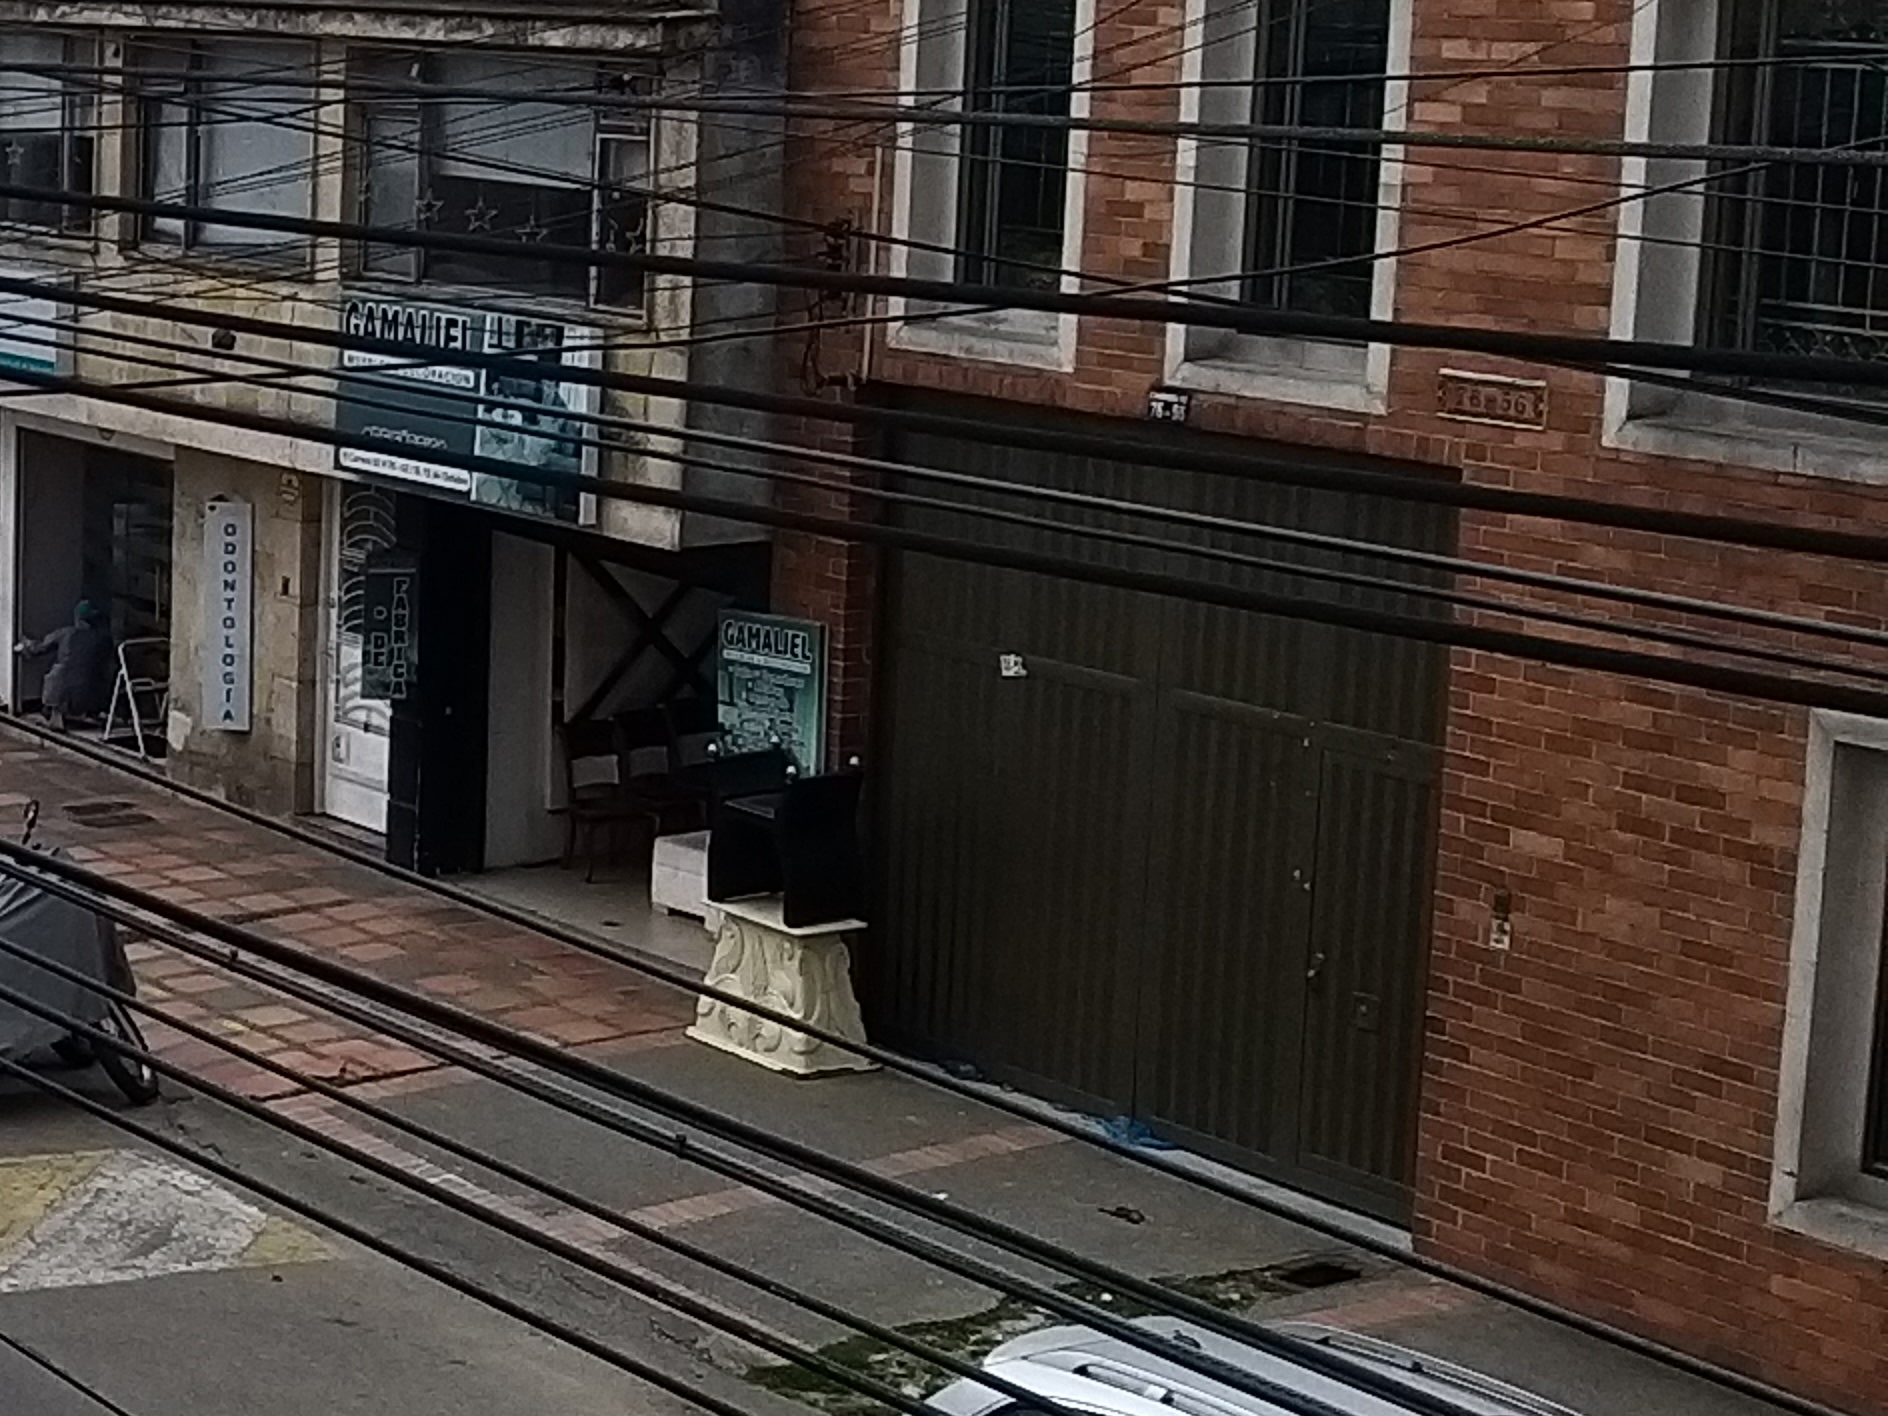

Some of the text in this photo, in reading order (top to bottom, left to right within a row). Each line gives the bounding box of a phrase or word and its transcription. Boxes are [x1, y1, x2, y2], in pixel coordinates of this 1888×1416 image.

[345, 300, 472, 353] GAMALIEL
[371, 632, 388, 668] DE
[390, 577, 411, 698] FABRICA
[723, 619, 813, 663] GAMALIEL
